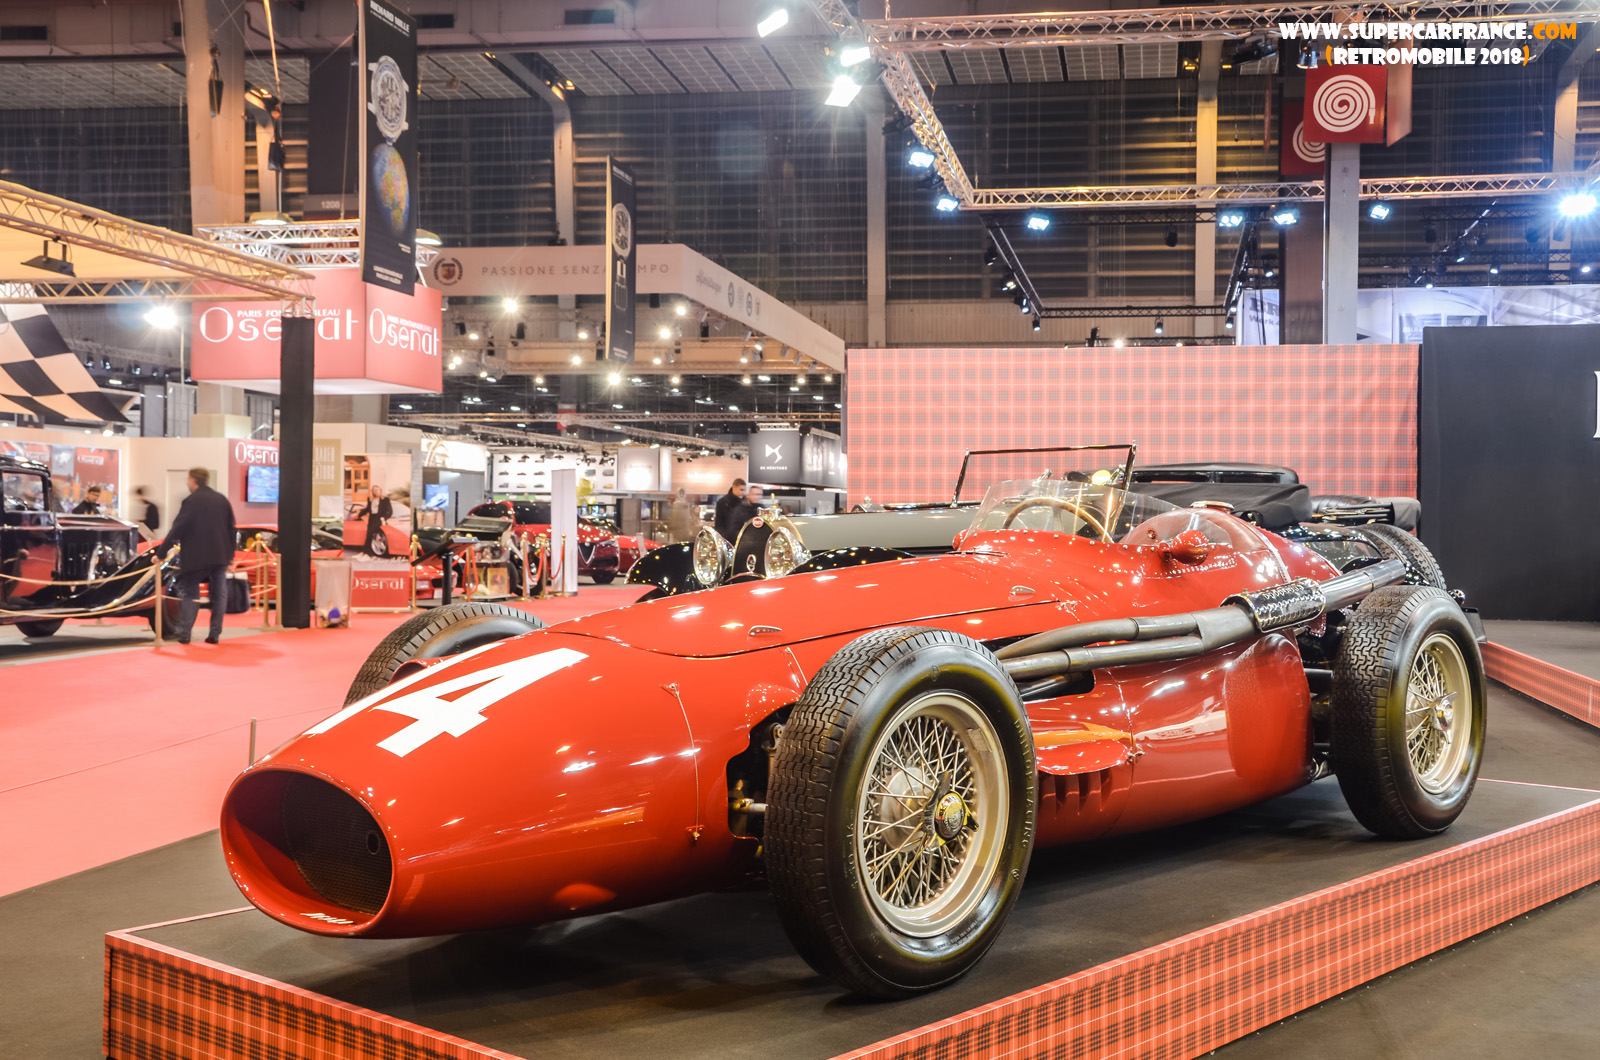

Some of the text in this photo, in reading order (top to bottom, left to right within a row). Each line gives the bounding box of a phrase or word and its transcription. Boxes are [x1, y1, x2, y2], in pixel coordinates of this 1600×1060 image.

[481, 265, 555, 276] PASSIONE
[637, 263, 669, 274] MPO
[199, 306, 359, 343] Oseat
[237, 309, 263, 318] PARIS
[369, 308, 440, 356] Osenat
[235, 441, 279, 465] Osena
